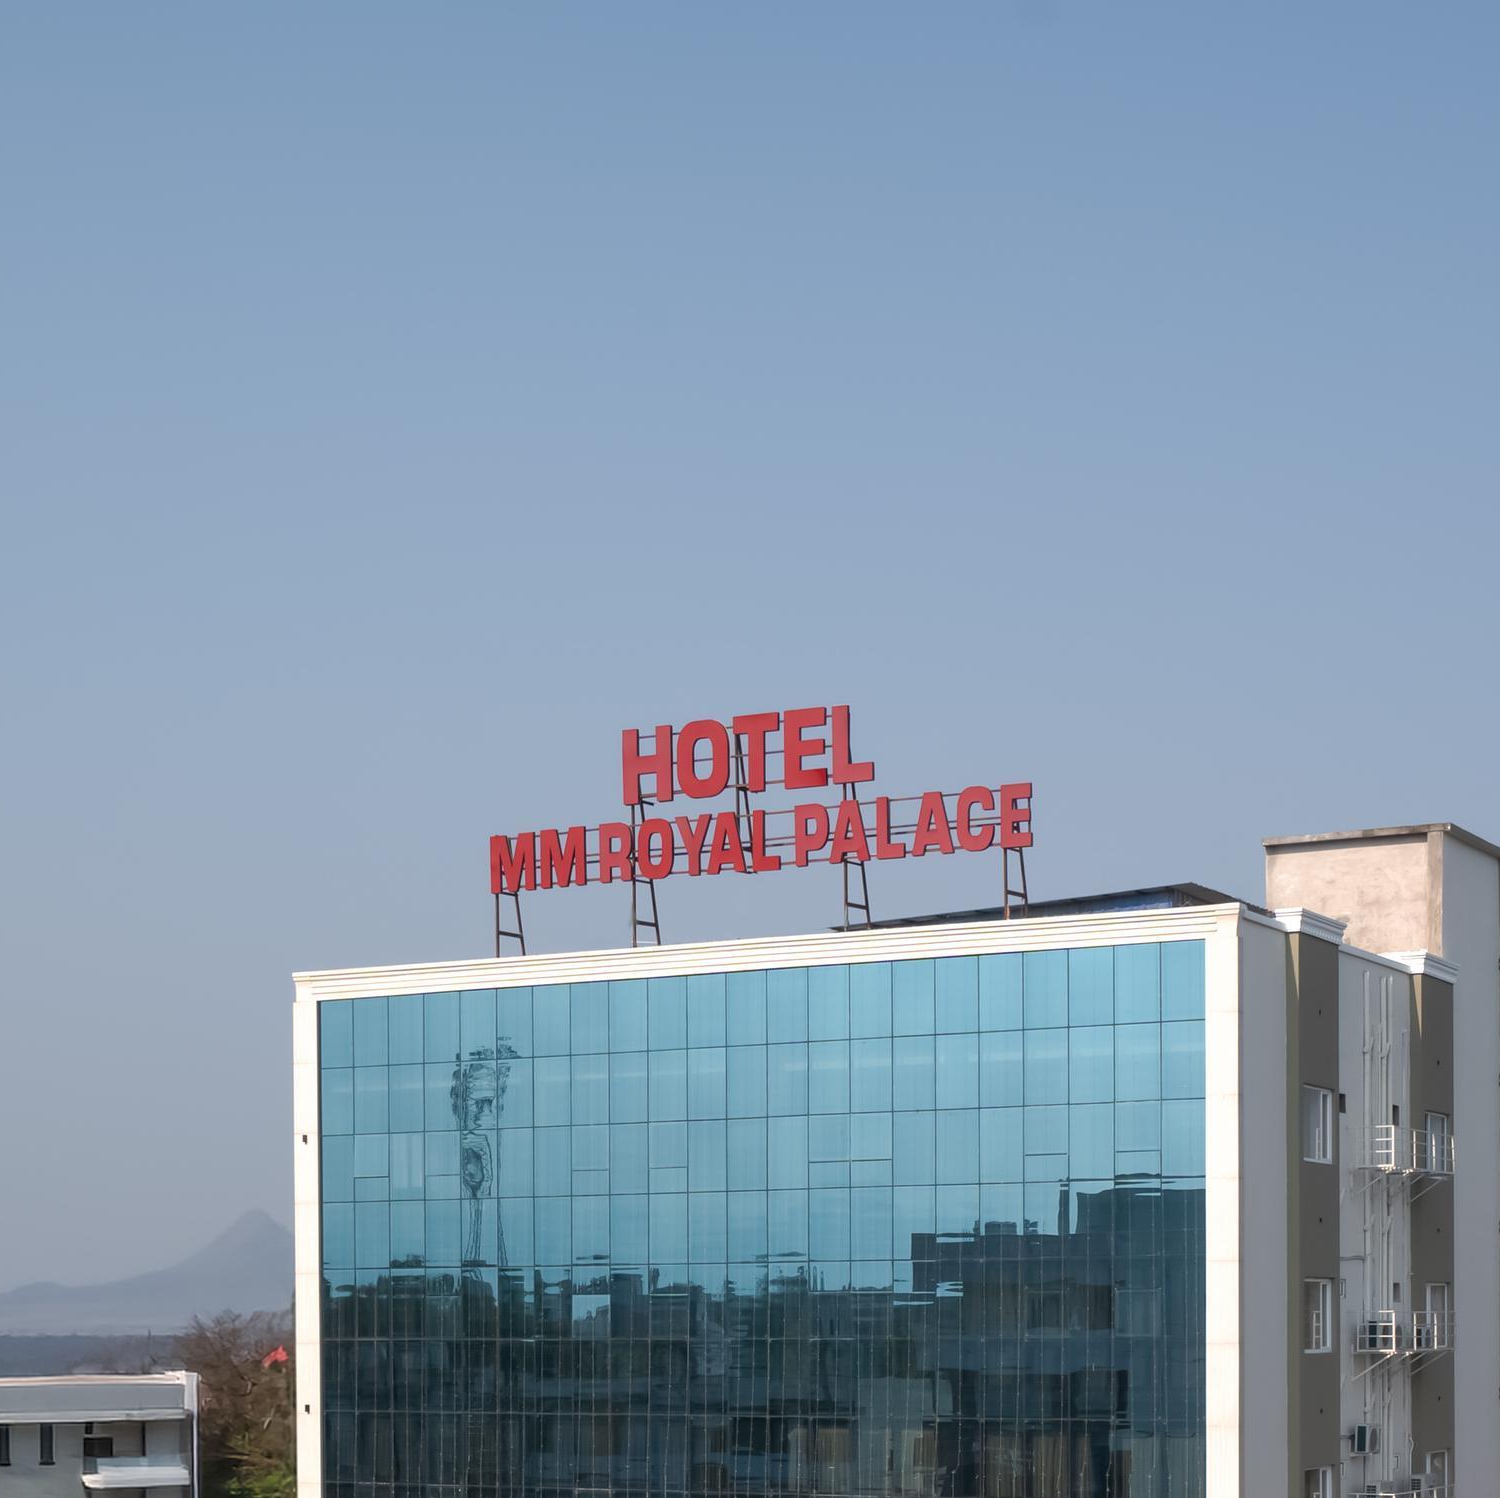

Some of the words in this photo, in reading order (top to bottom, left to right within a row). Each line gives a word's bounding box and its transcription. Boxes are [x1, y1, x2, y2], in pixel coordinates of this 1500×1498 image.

[622, 705, 875, 806] HOTEL
[489, 825, 587, 894] MM
[599, 809, 781, 883] ROYAL
[794, 782, 1033, 868] PALACE
